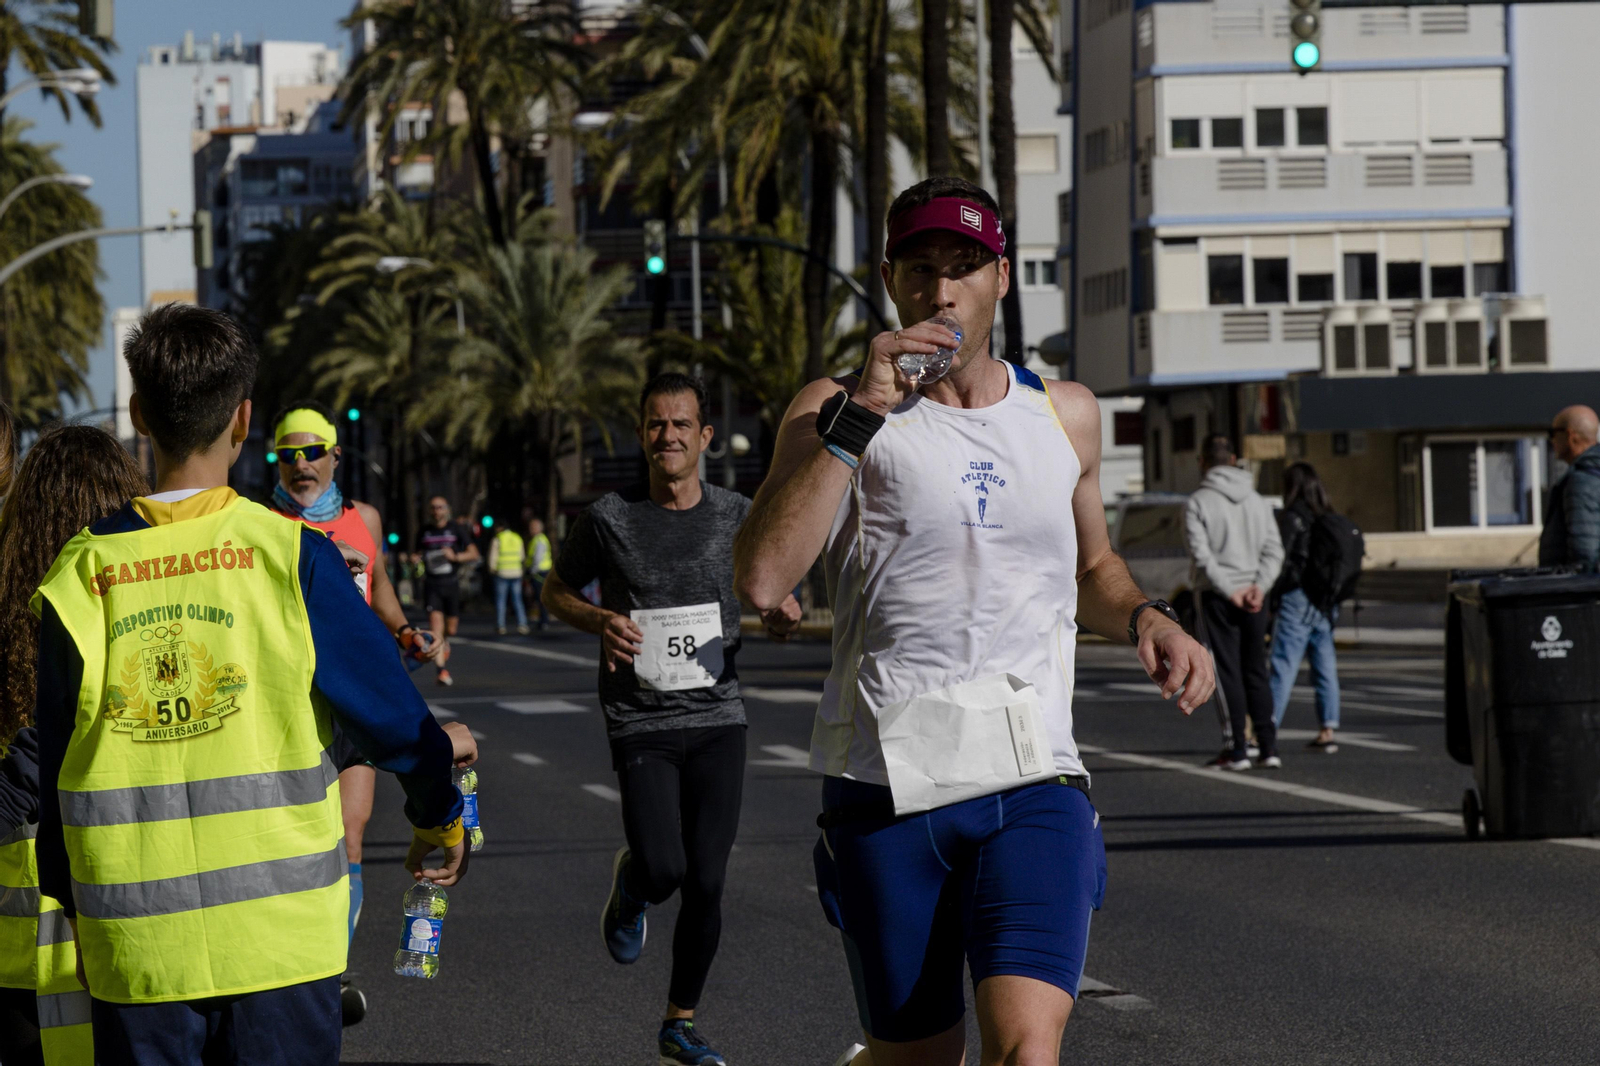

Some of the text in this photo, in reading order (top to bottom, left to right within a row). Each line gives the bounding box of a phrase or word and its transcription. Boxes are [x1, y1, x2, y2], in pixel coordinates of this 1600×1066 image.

[969, 461, 994, 471] CLUB
[961, 472, 1006, 488] ATLETICO
[187, 603, 234, 629] OLIMPO
[667, 635, 697, 658] 58
[157, 696, 191, 726] 50
[145, 721, 209, 740] ANIVERSARIO
